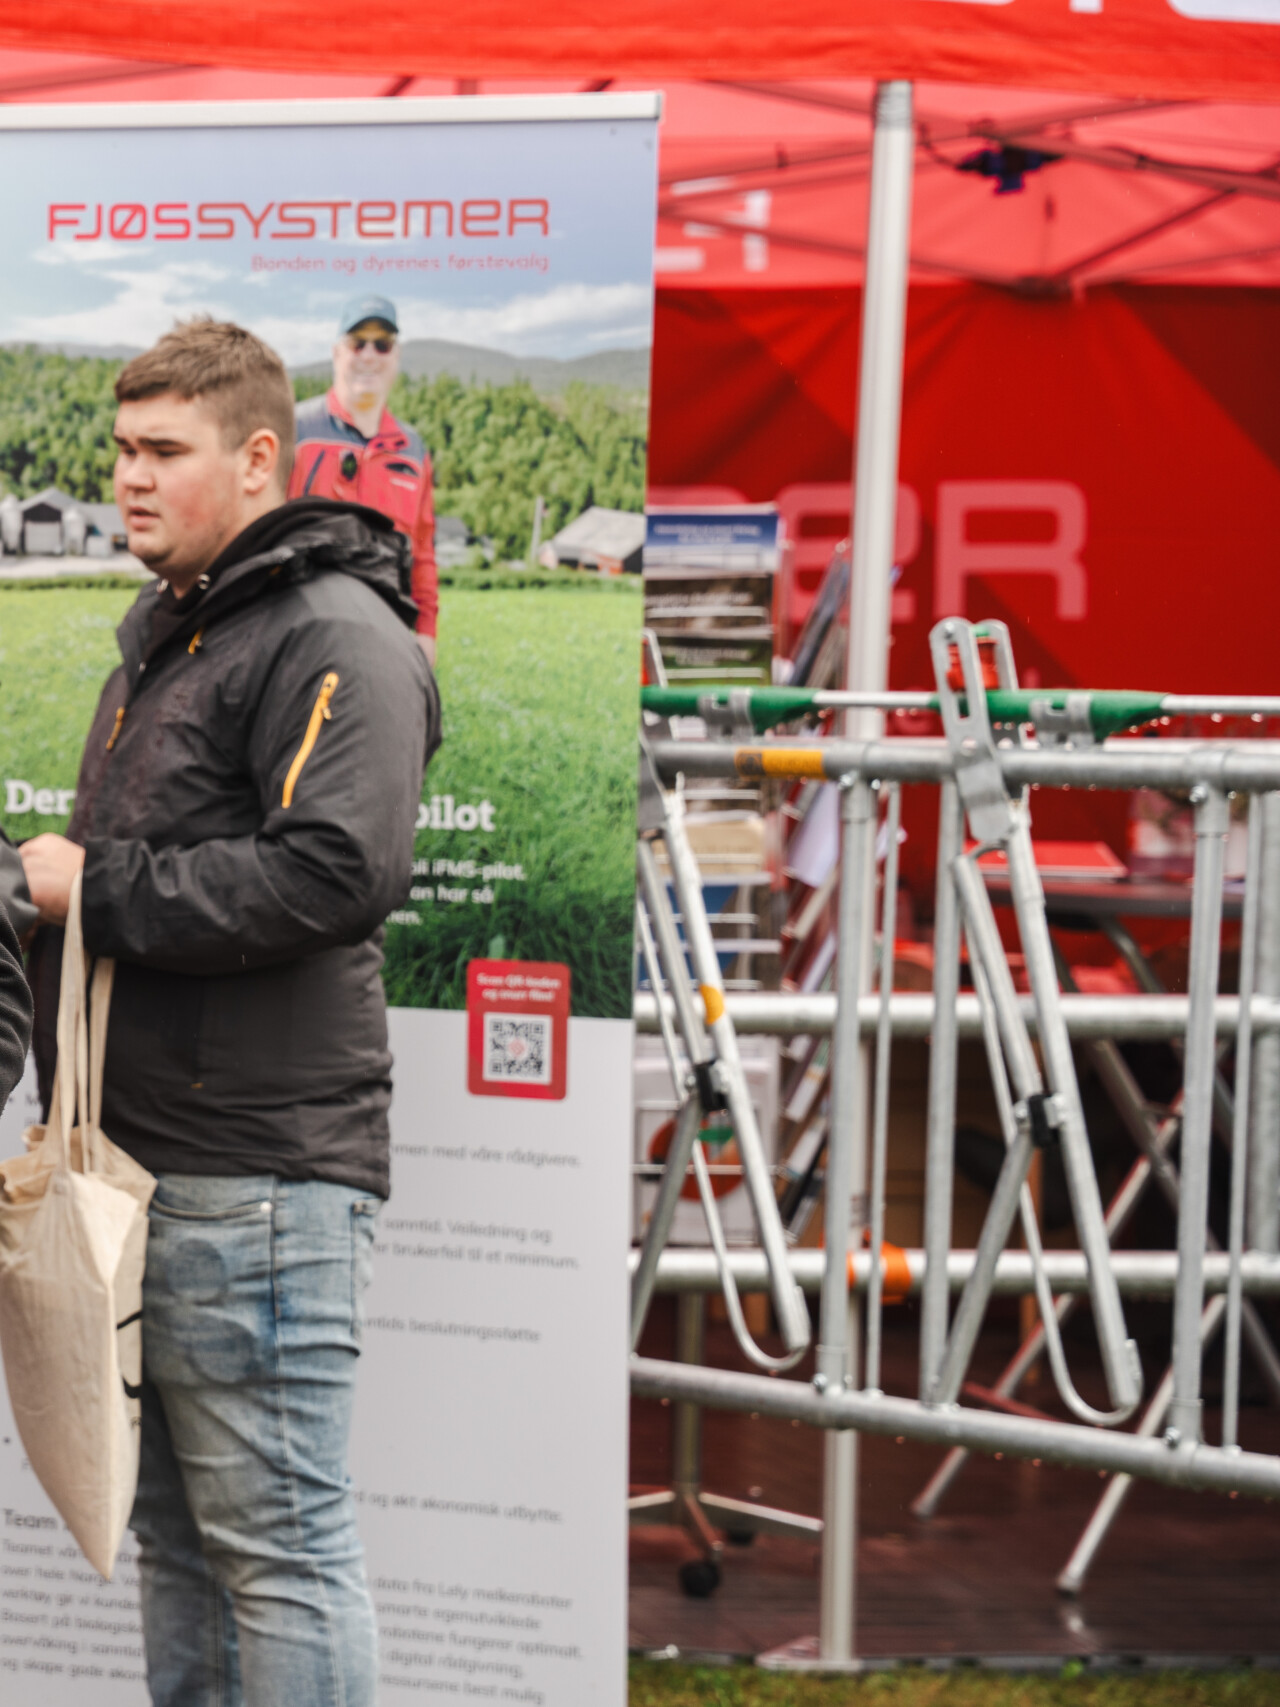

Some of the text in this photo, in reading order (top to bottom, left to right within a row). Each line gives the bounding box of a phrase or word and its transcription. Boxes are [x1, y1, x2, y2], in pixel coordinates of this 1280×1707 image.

[252, 253, 549, 275] Bonden og dyrenes førstevalg
[2, 1508, 57, 1531] Team
